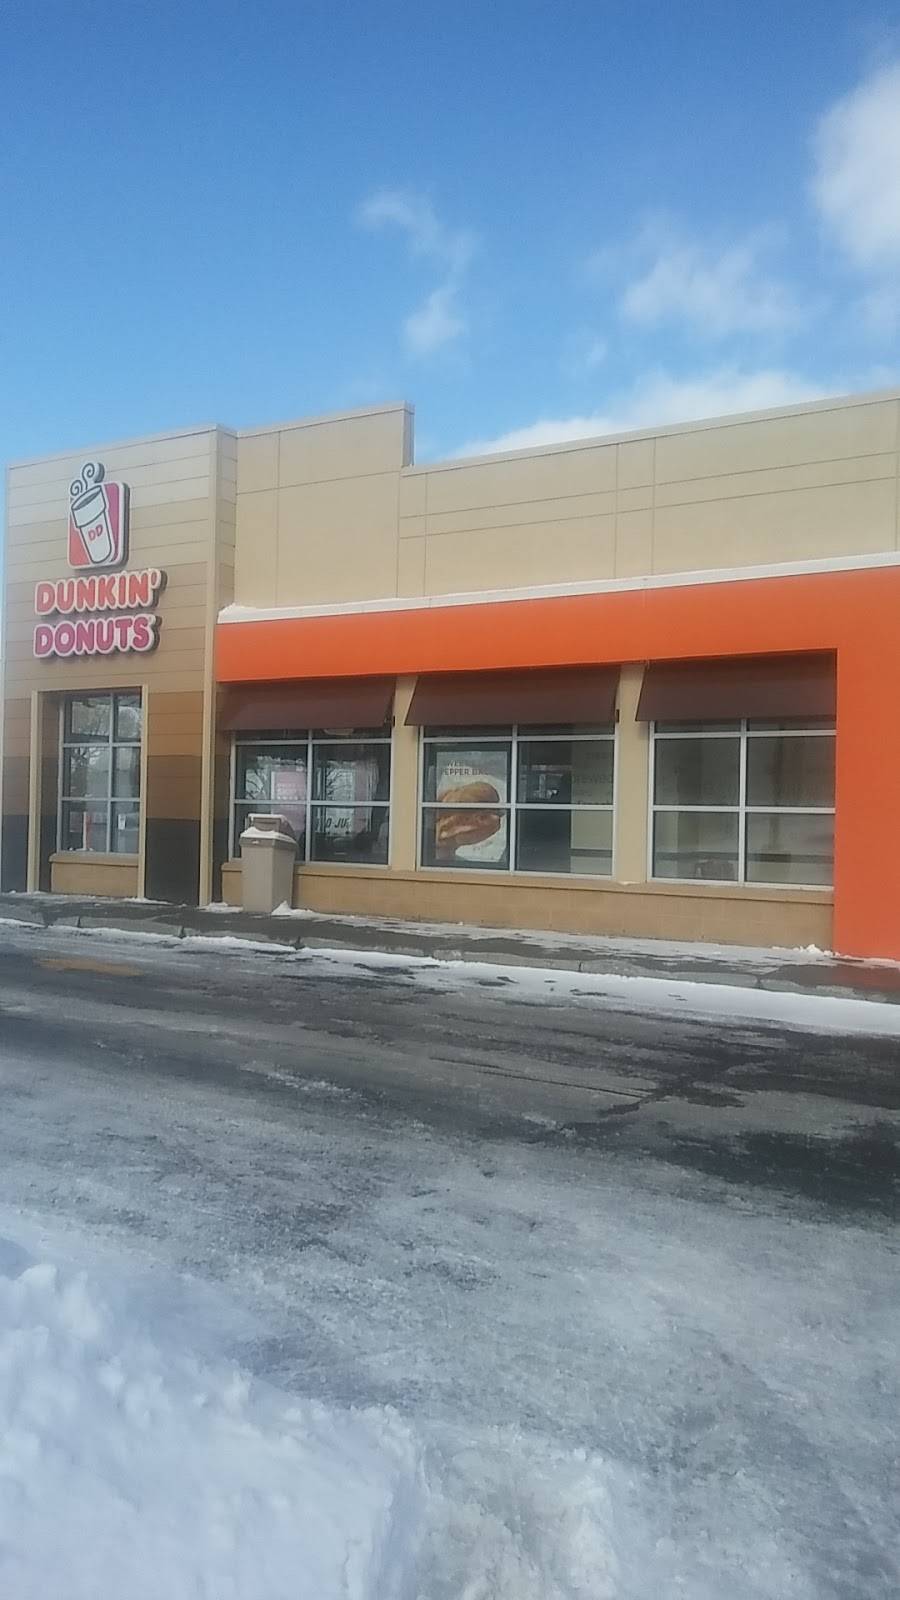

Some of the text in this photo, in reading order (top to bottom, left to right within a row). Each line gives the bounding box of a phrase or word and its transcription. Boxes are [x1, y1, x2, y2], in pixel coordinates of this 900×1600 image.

[88, 523, 103, 541] DD
[35, 570, 160, 613] DUNKIN'
[34, 615, 152, 656] DONUTS
